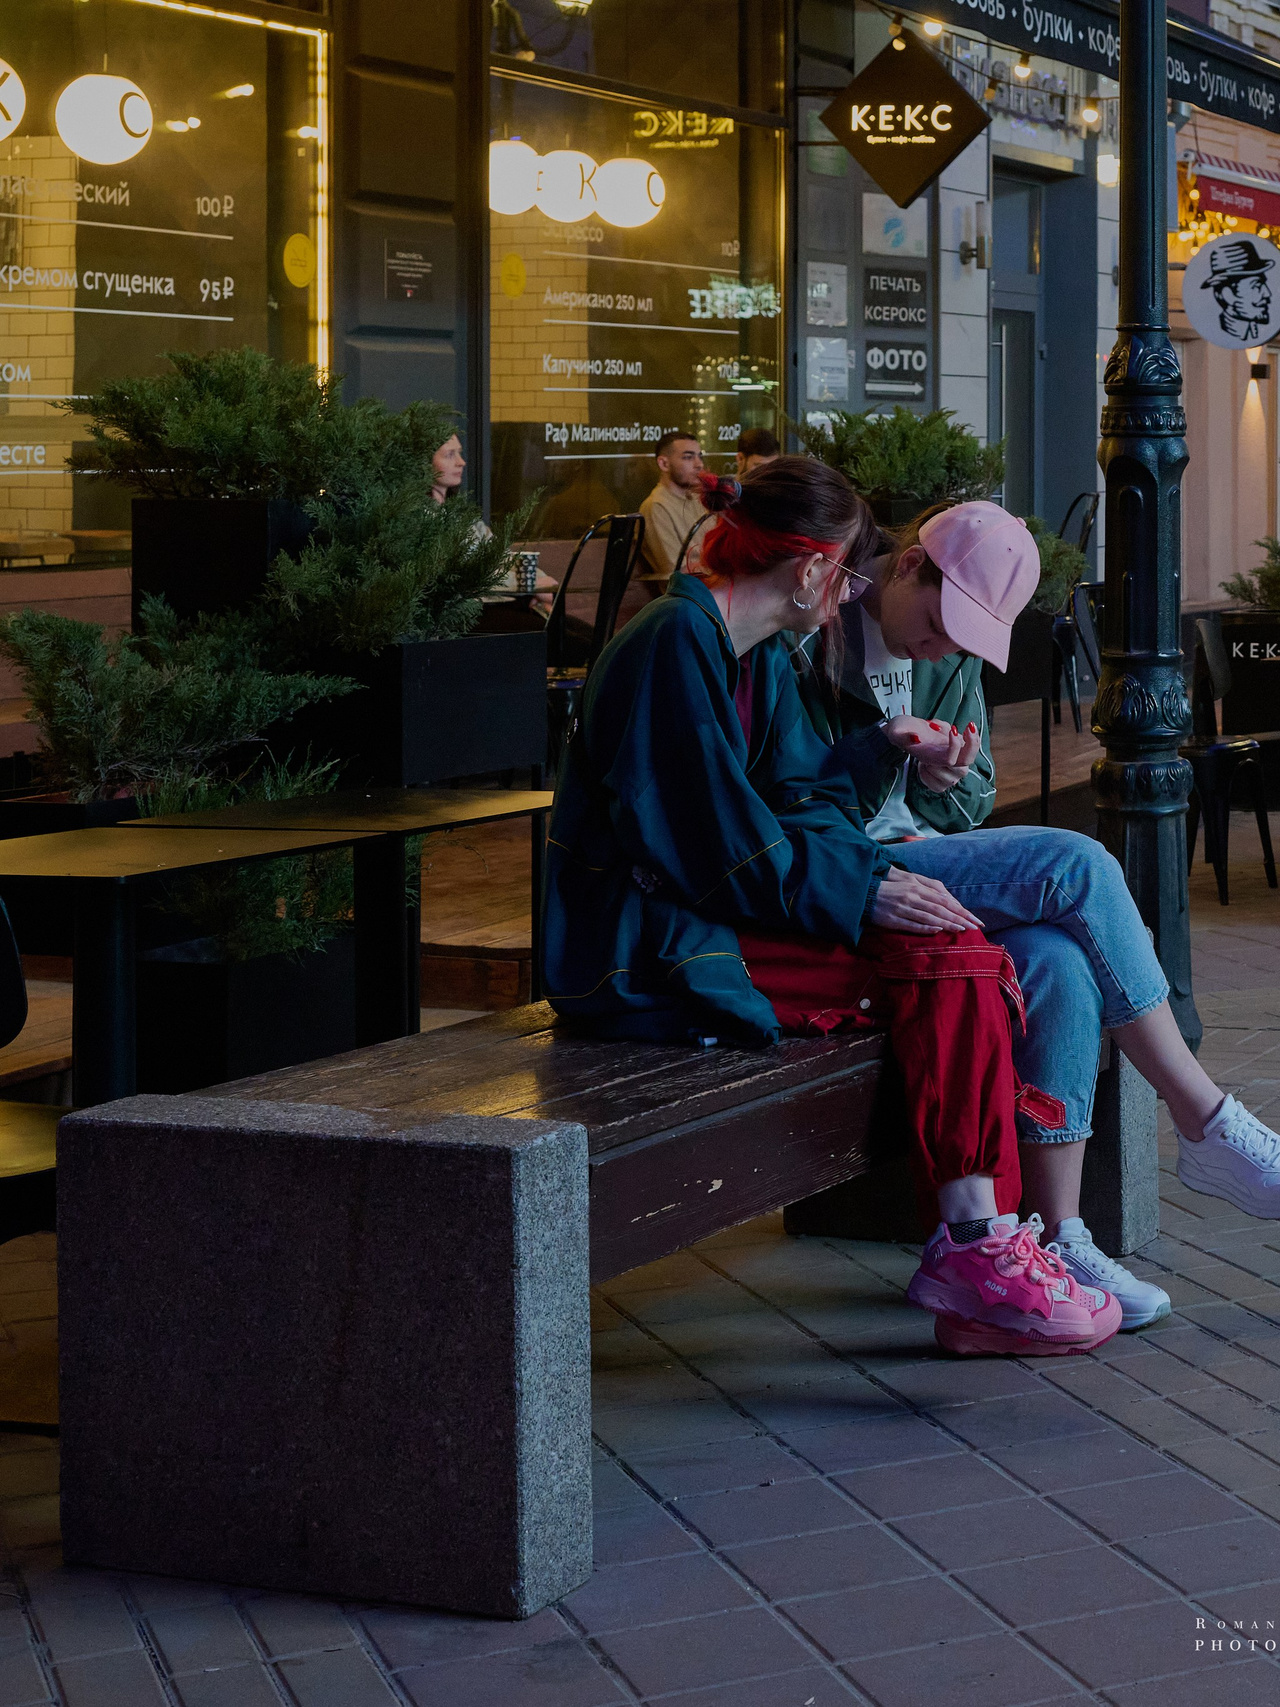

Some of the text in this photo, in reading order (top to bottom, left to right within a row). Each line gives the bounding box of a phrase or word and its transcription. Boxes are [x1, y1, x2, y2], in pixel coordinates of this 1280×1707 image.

[1022, 0, 1074, 43] булки
[1166, 56, 1191, 85] овь
[1199, 60, 1238, 102] булки
[1247, 84, 1276, 120] кофе
[82, 269, 176, 299] сгущенка
[869, 275, 922, 293] ПЕЧАТЬ
[543, 285, 654, 313] Американо 250 мл
[864, 305, 927, 323] КСЕРОКС
[542, 353, 602, 380] Капучино
[604, 359, 625, 376] 250
[625, 360, 643, 377] мл
[866, 346, 928, 372] ФОТО
[545, 422, 570, 448] Раф
[571, 422, 641, 443] Малиновый
[642, 425, 662, 442] 250
[984, 1279, 1008, 1297] MOMS
